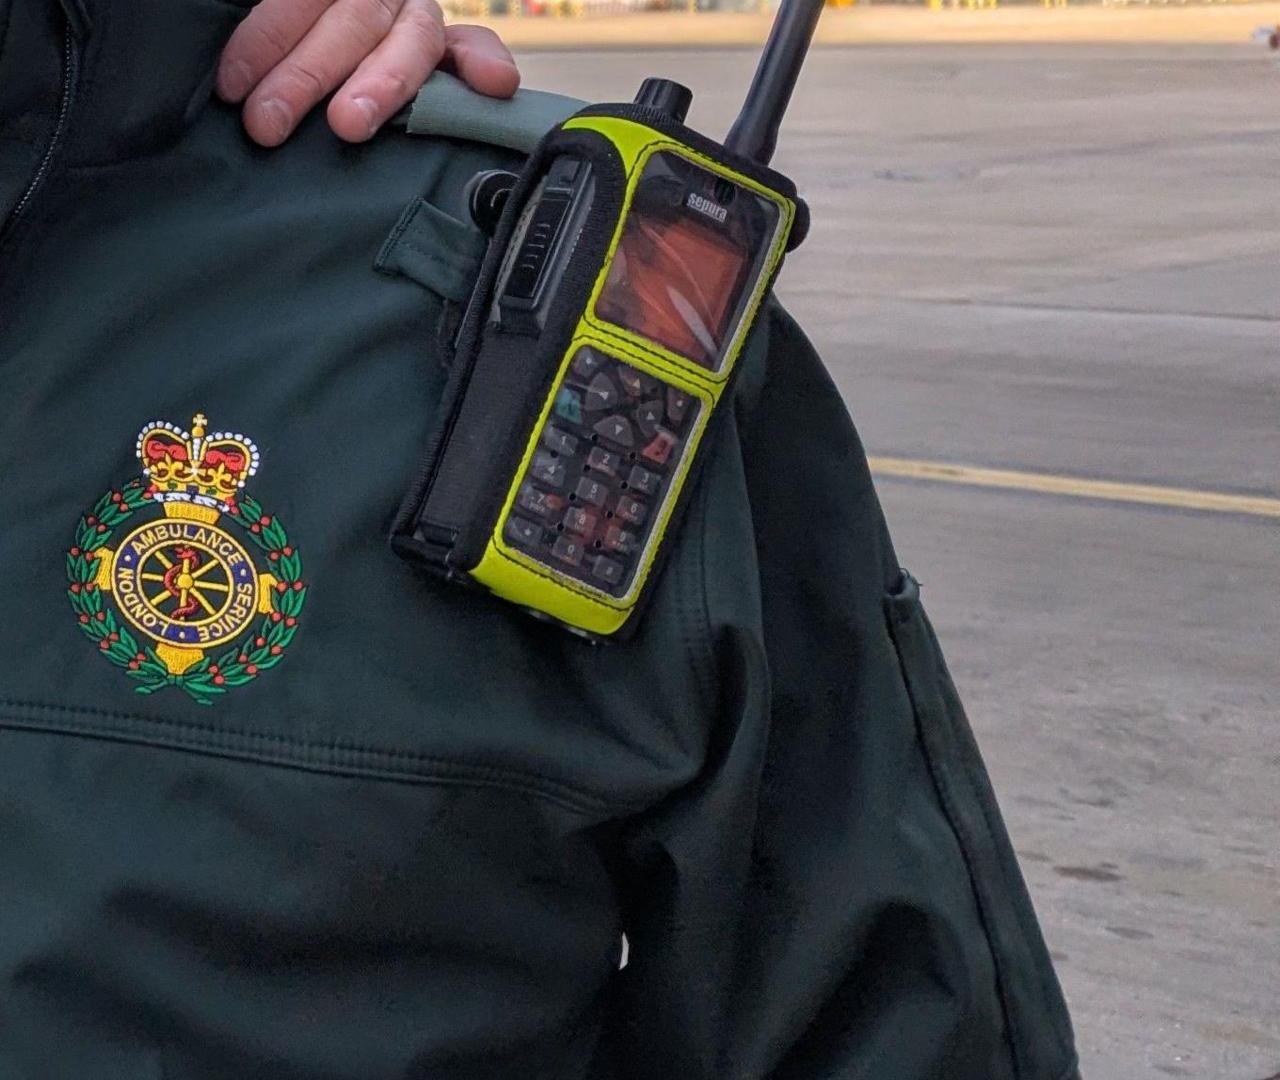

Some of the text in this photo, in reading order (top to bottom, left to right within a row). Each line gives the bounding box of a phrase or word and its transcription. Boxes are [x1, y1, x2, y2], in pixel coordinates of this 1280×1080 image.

[687, 193, 728, 221] sepura
[130, 524, 244, 567] AMBULANCE
[117, 567, 171, 636] LONDON
[197, 582, 253, 642] SERVICE
